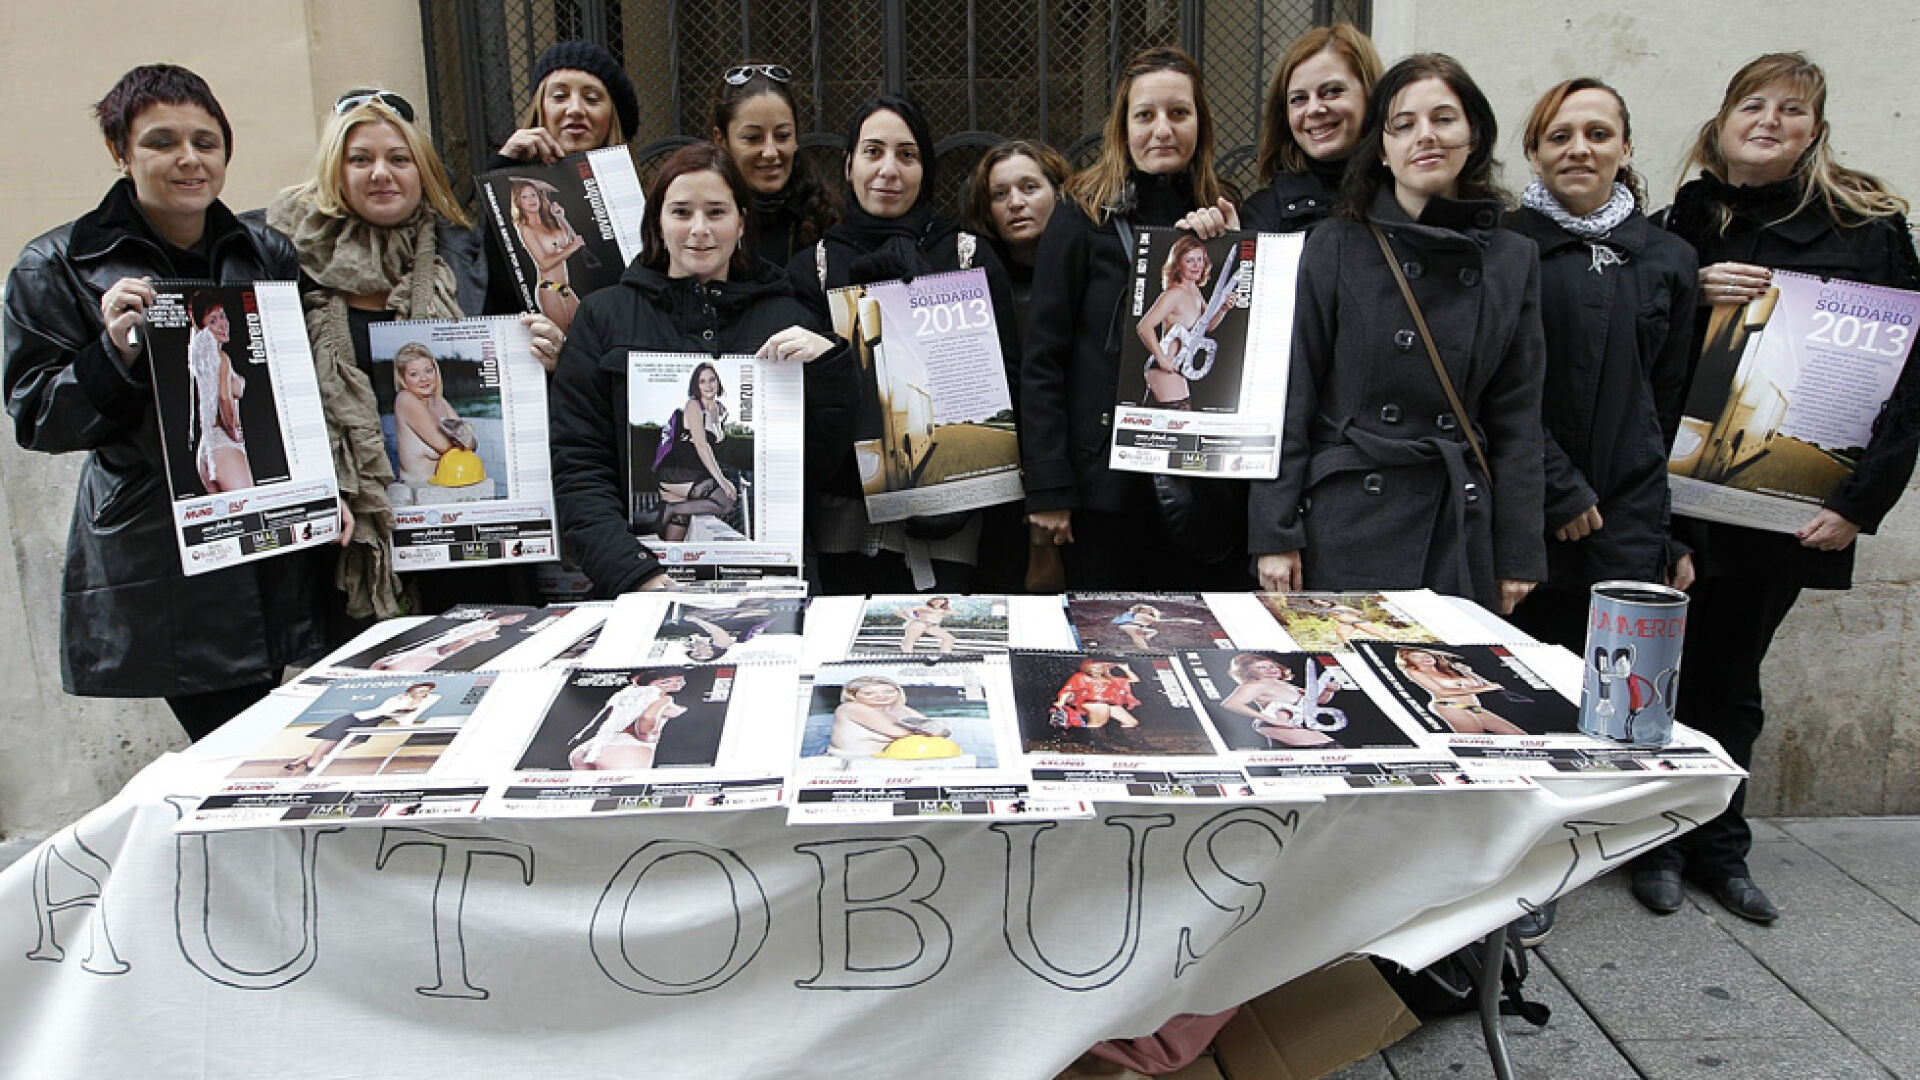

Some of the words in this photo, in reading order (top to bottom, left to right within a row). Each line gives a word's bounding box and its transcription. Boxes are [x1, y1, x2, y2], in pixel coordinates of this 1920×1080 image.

[910, 288, 984, 309] SOLIDARIO
[1815, 299, 1912, 326] SOLIDARIO
[913, 299, 990, 336] 2013
[1805, 310, 1909, 357] 2013
[245, 313, 267, 365] febrero
[478, 360, 502, 389] julio
[26, 796, 1300, 1001] AUTOBUS
